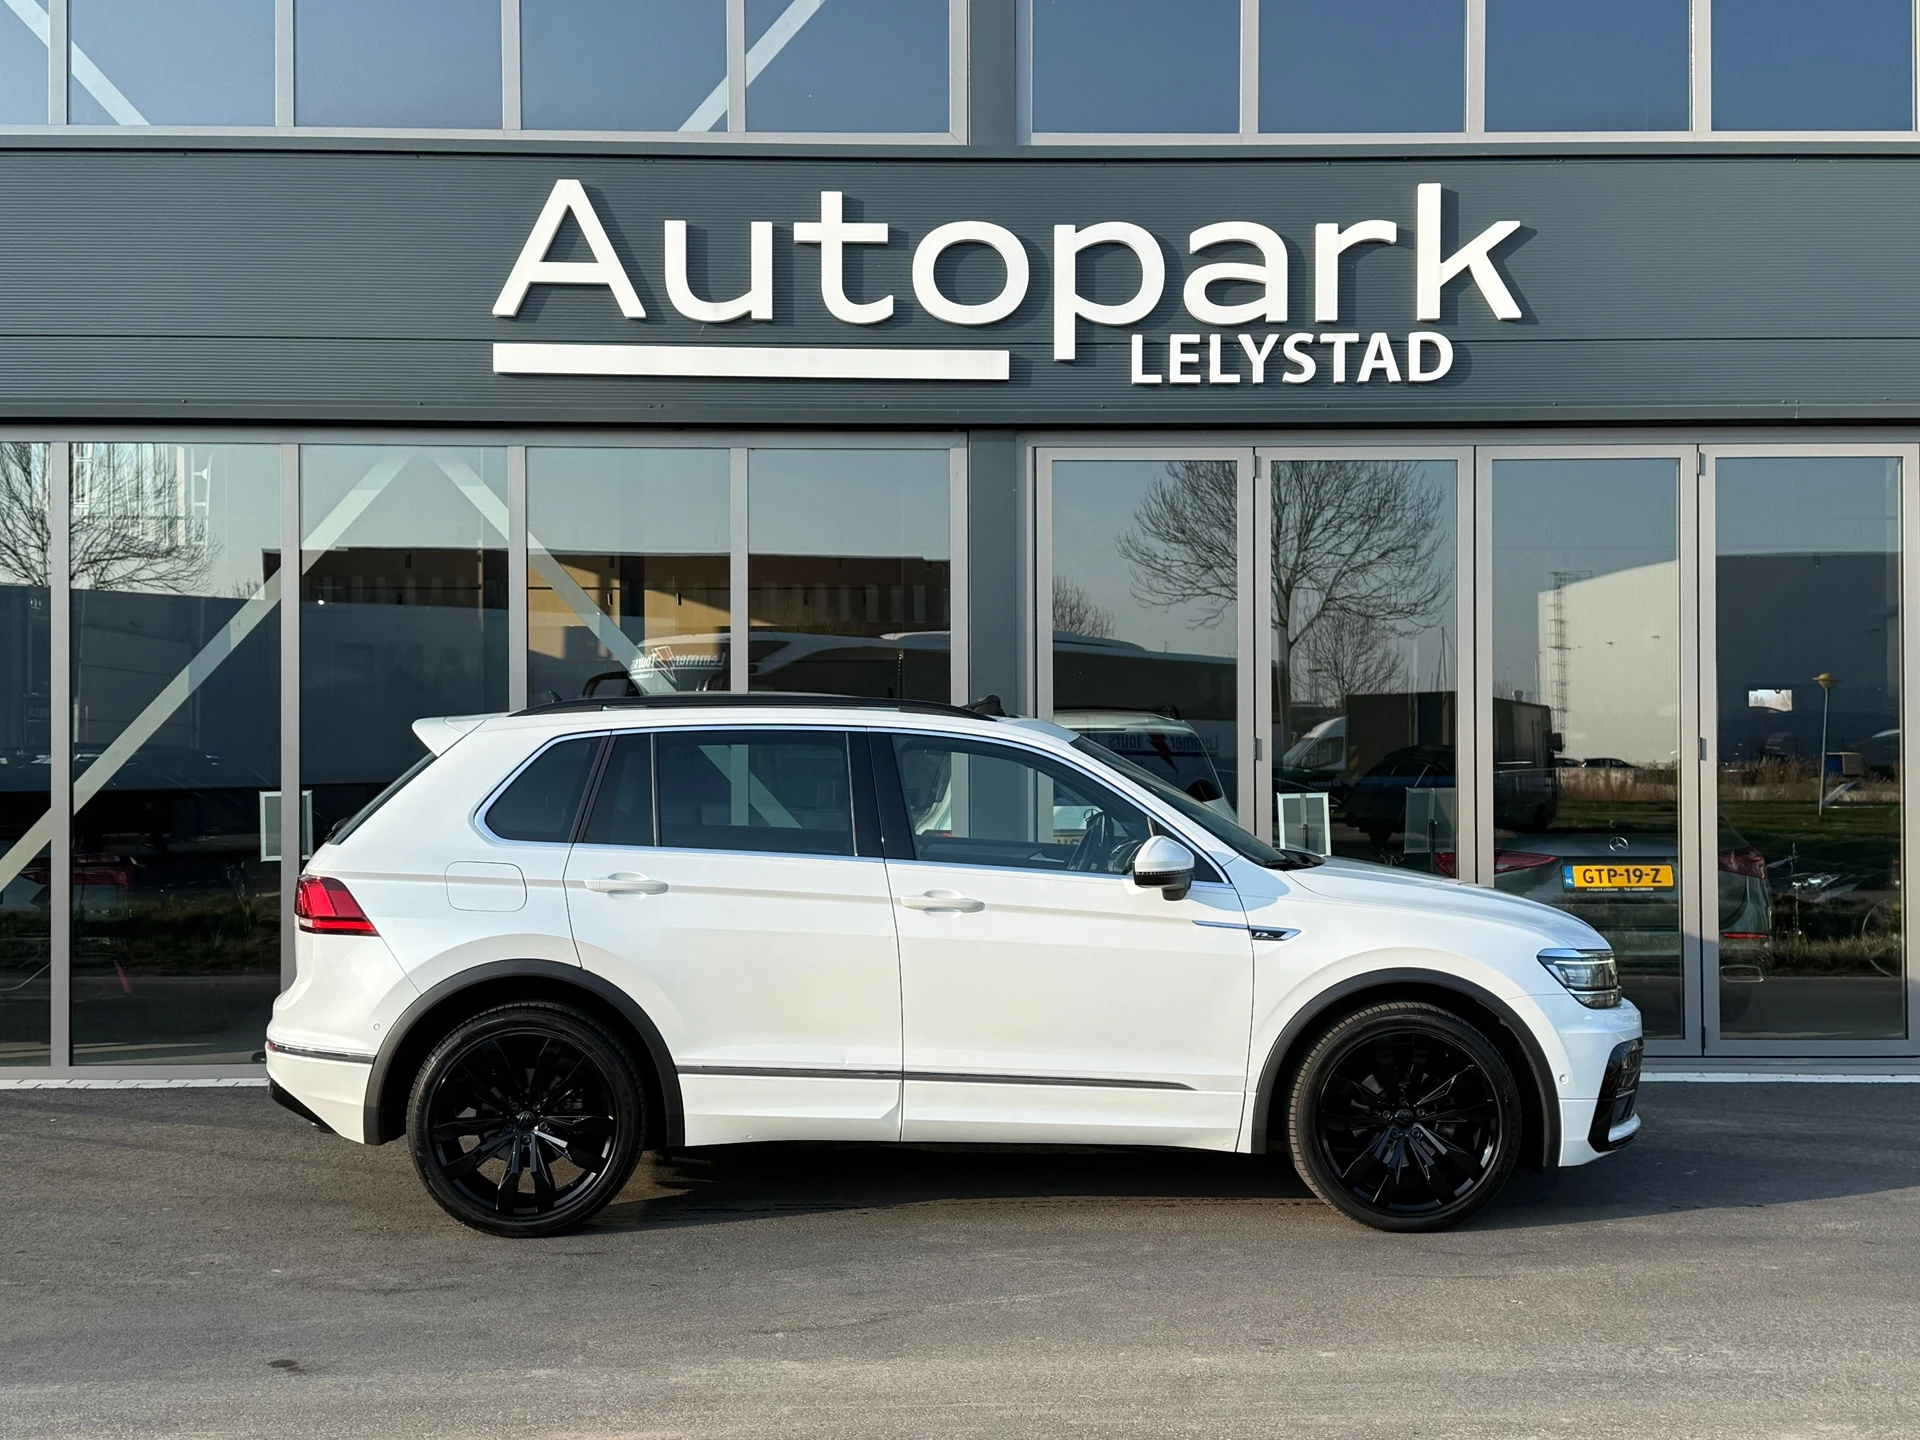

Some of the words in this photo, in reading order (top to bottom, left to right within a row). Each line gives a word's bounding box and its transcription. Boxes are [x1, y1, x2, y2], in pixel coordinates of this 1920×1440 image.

[492, 179, 1522, 361] Autopark
[1131, 332, 1454, 384] LELYSTAD
[1582, 868, 1662, 884] GTP-19-Z
